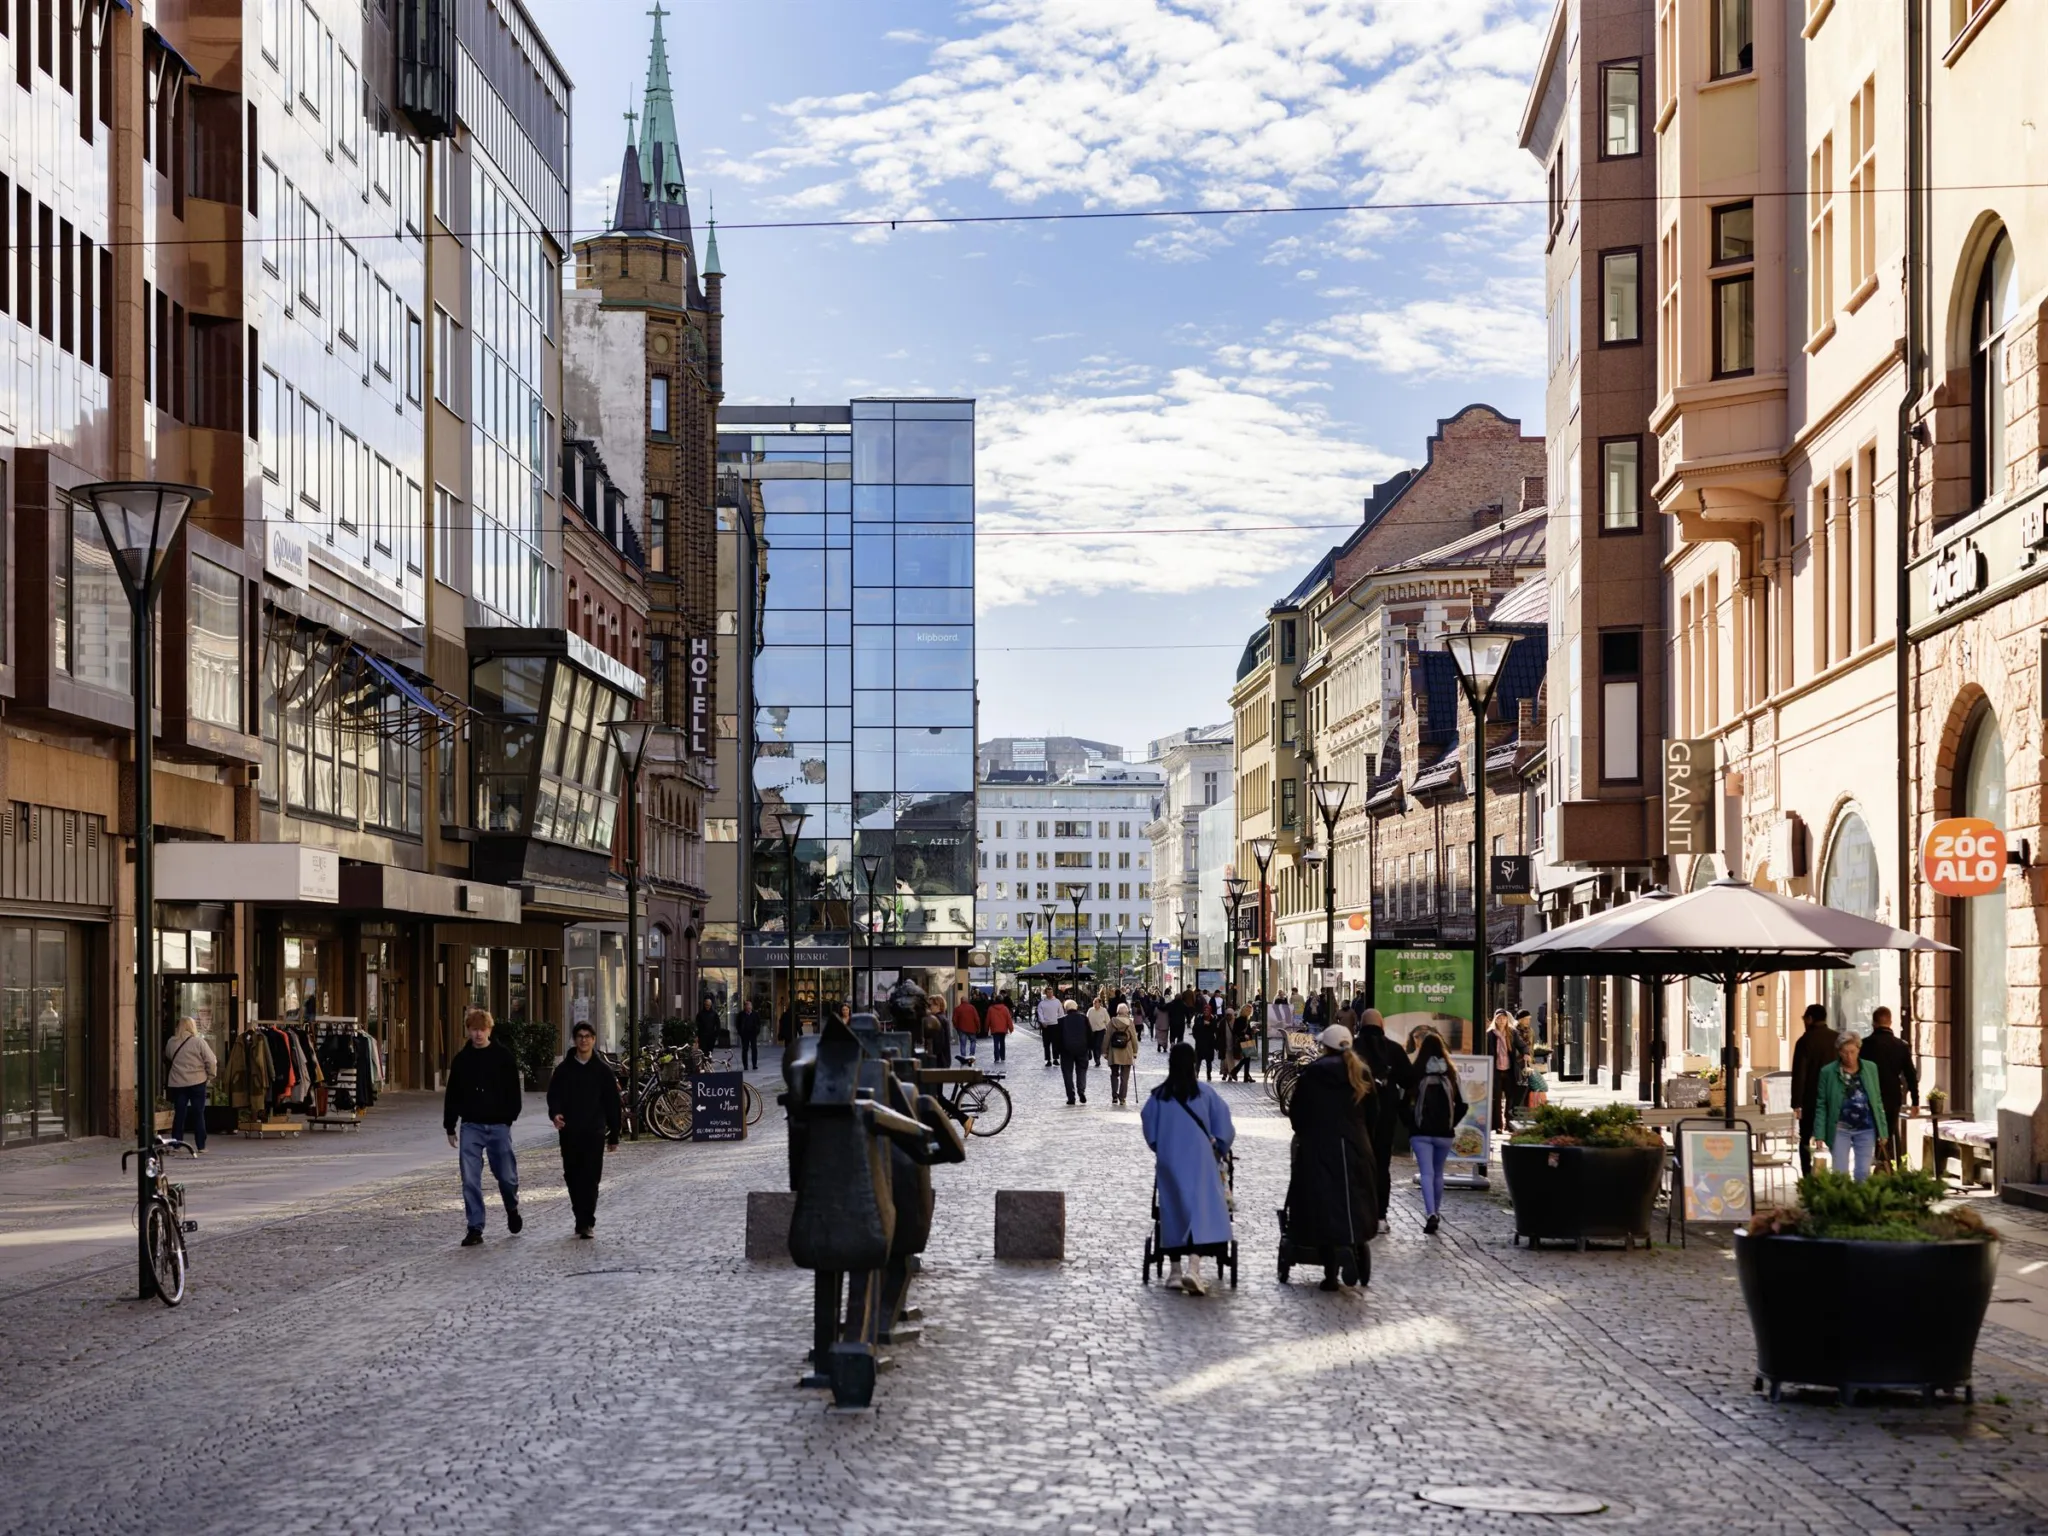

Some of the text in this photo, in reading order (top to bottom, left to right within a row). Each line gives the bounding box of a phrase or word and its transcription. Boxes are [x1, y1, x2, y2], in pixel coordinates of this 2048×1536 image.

[691, 638, 708, 752] HOTELL
[1668, 742, 1691, 851] GRANIT
[930, 837, 960, 846] AZETS
[1934, 828, 1997, 858] ZÓC
[1933, 860, 1998, 883] ALO
[765, 953, 828, 961] JOHN HENRIC
[1396, 952, 1453, 960] ARKEN ZOO
[1434, 972, 1456, 981] oss
[1393, 982, 1455, 993] om foder
